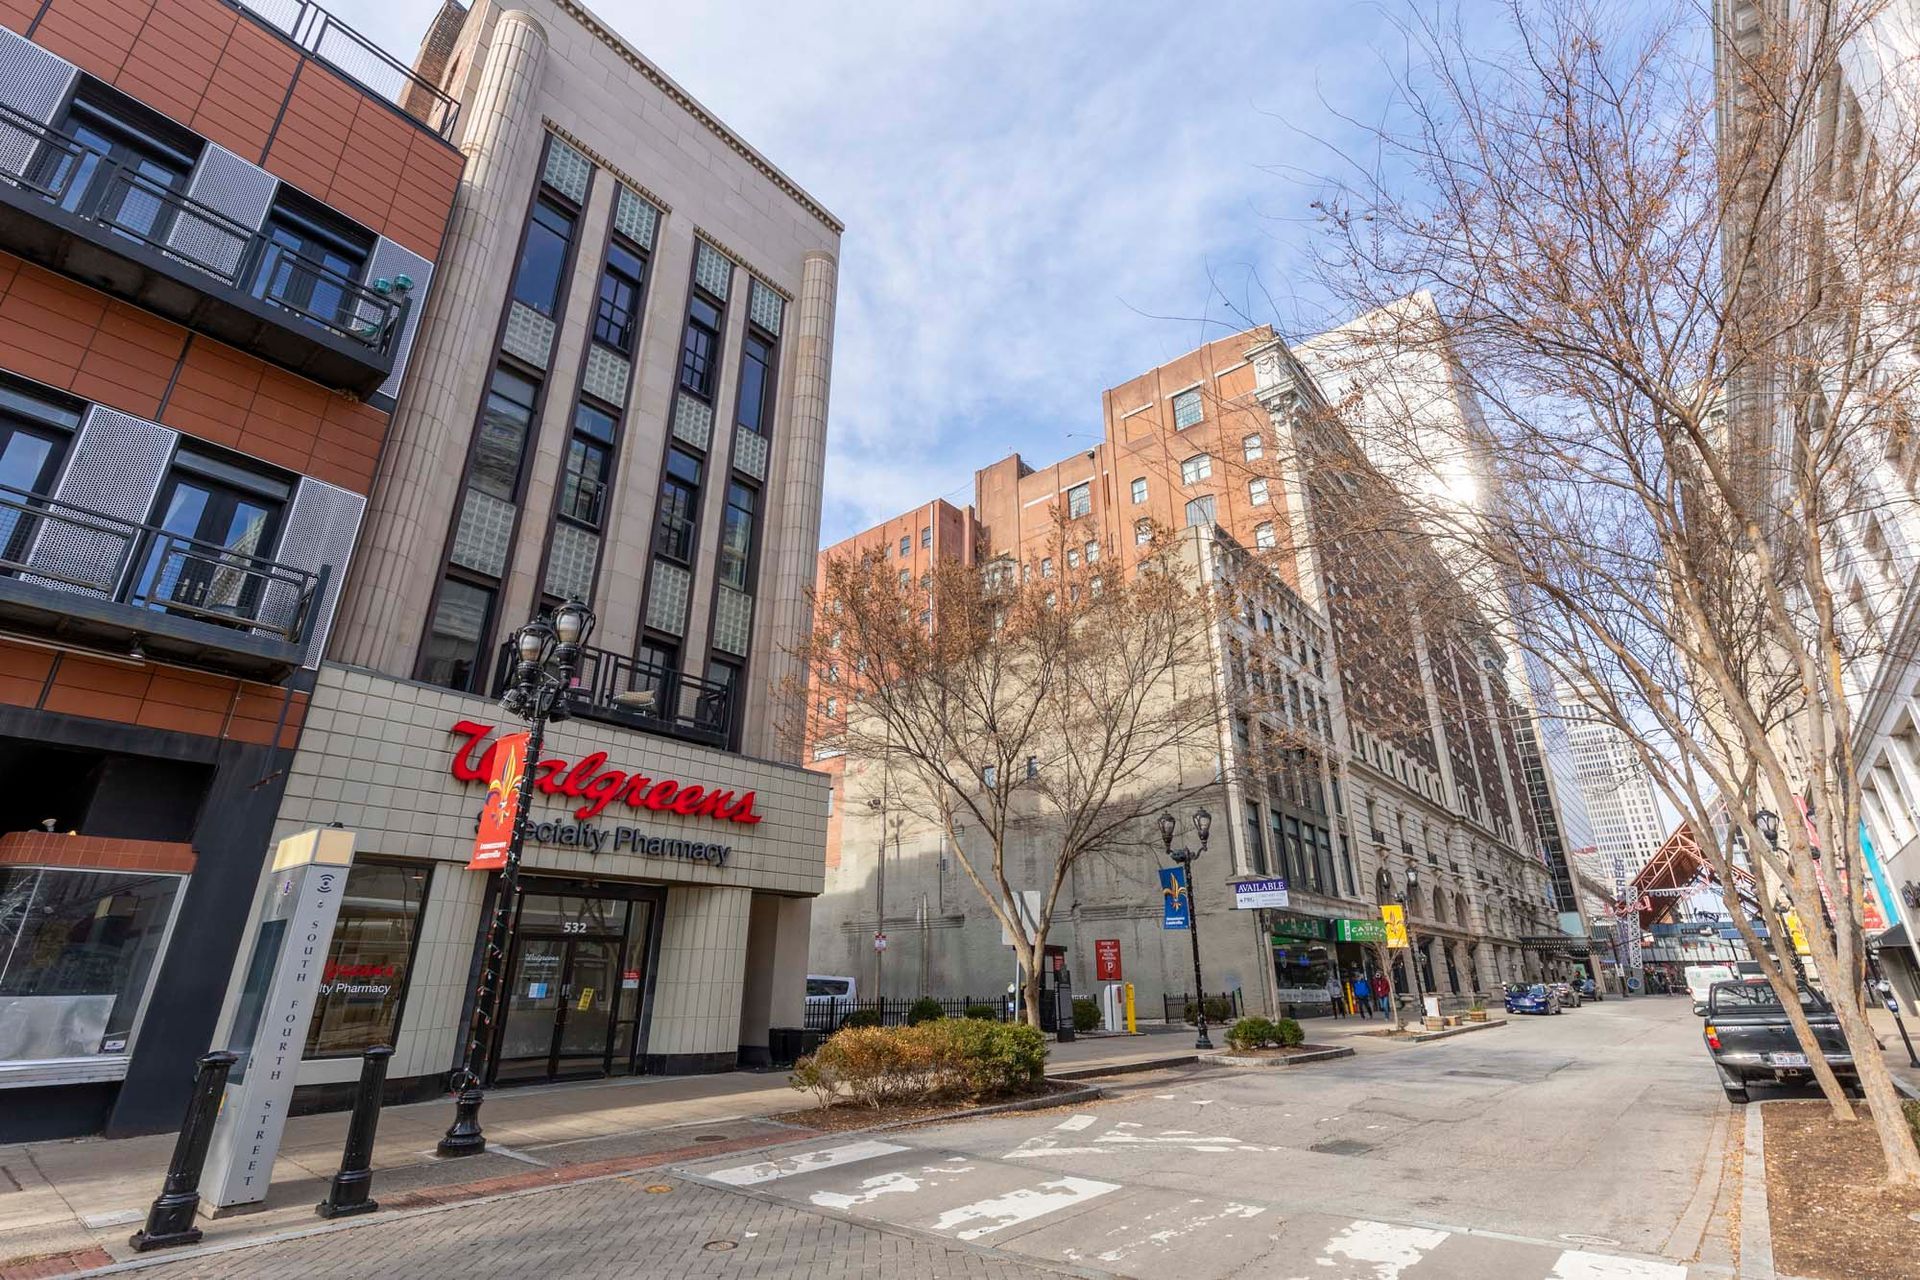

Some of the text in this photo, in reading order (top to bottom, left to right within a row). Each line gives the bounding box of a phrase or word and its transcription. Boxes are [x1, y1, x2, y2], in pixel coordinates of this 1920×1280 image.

[475, 809, 732, 867] ecialty Pharmacy
[1238, 881, 1285, 893] AVAILABLE
[563, 922, 588, 933] 532
[336, 982, 392, 995] Pharmacy
[244, 920, 320, 1187] SOUTH FOURTH STREET
